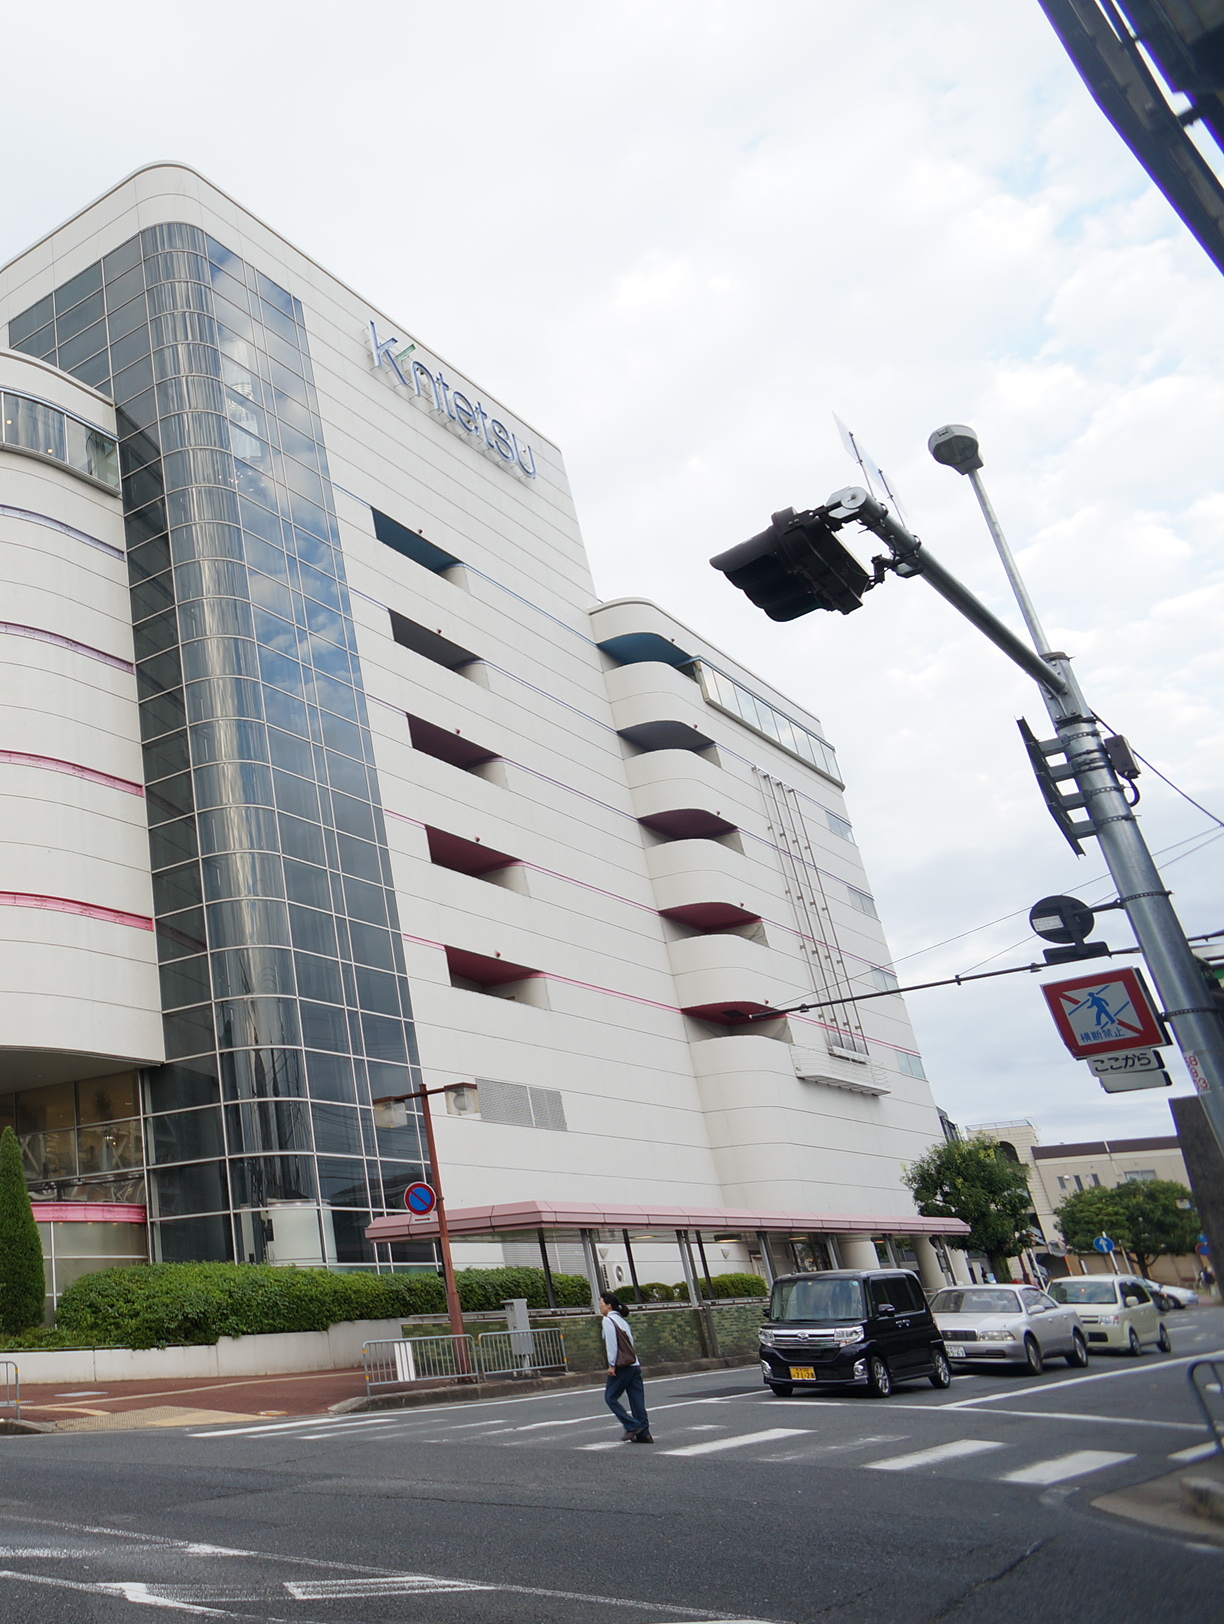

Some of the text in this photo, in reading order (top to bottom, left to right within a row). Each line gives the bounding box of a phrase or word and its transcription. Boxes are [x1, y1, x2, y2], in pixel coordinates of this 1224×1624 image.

[1080, 1027, 1125, 1043] 横断禁止
[1093, 1052, 1151, 1072] ここから
